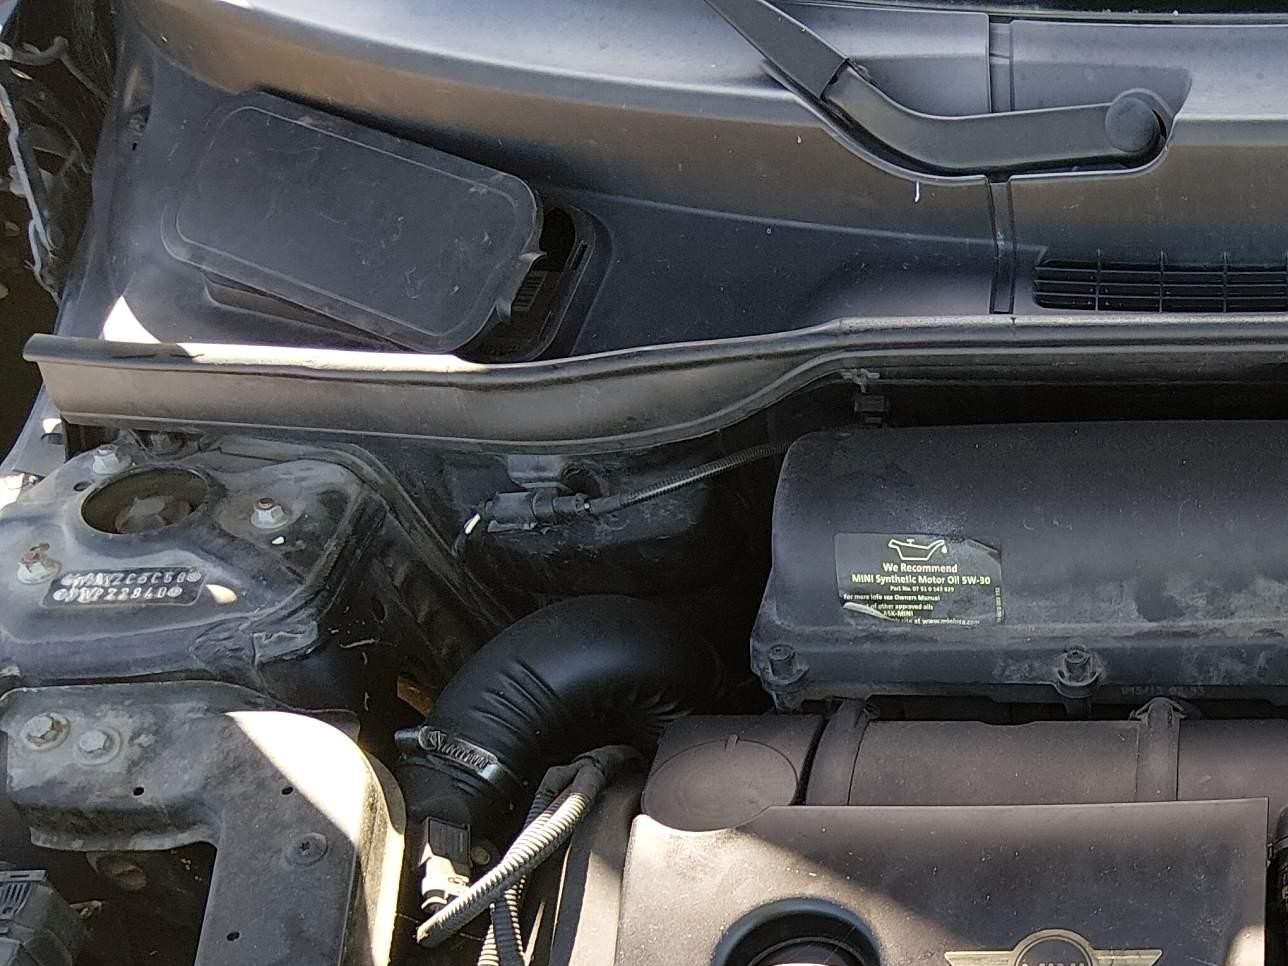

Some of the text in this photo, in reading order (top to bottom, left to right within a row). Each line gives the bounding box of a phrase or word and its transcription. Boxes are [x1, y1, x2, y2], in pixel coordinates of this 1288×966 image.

[882, 563, 958, 573] We Recommend
[852, 574, 991, 585] MINI Synthetic Motor Oil 5W-30
